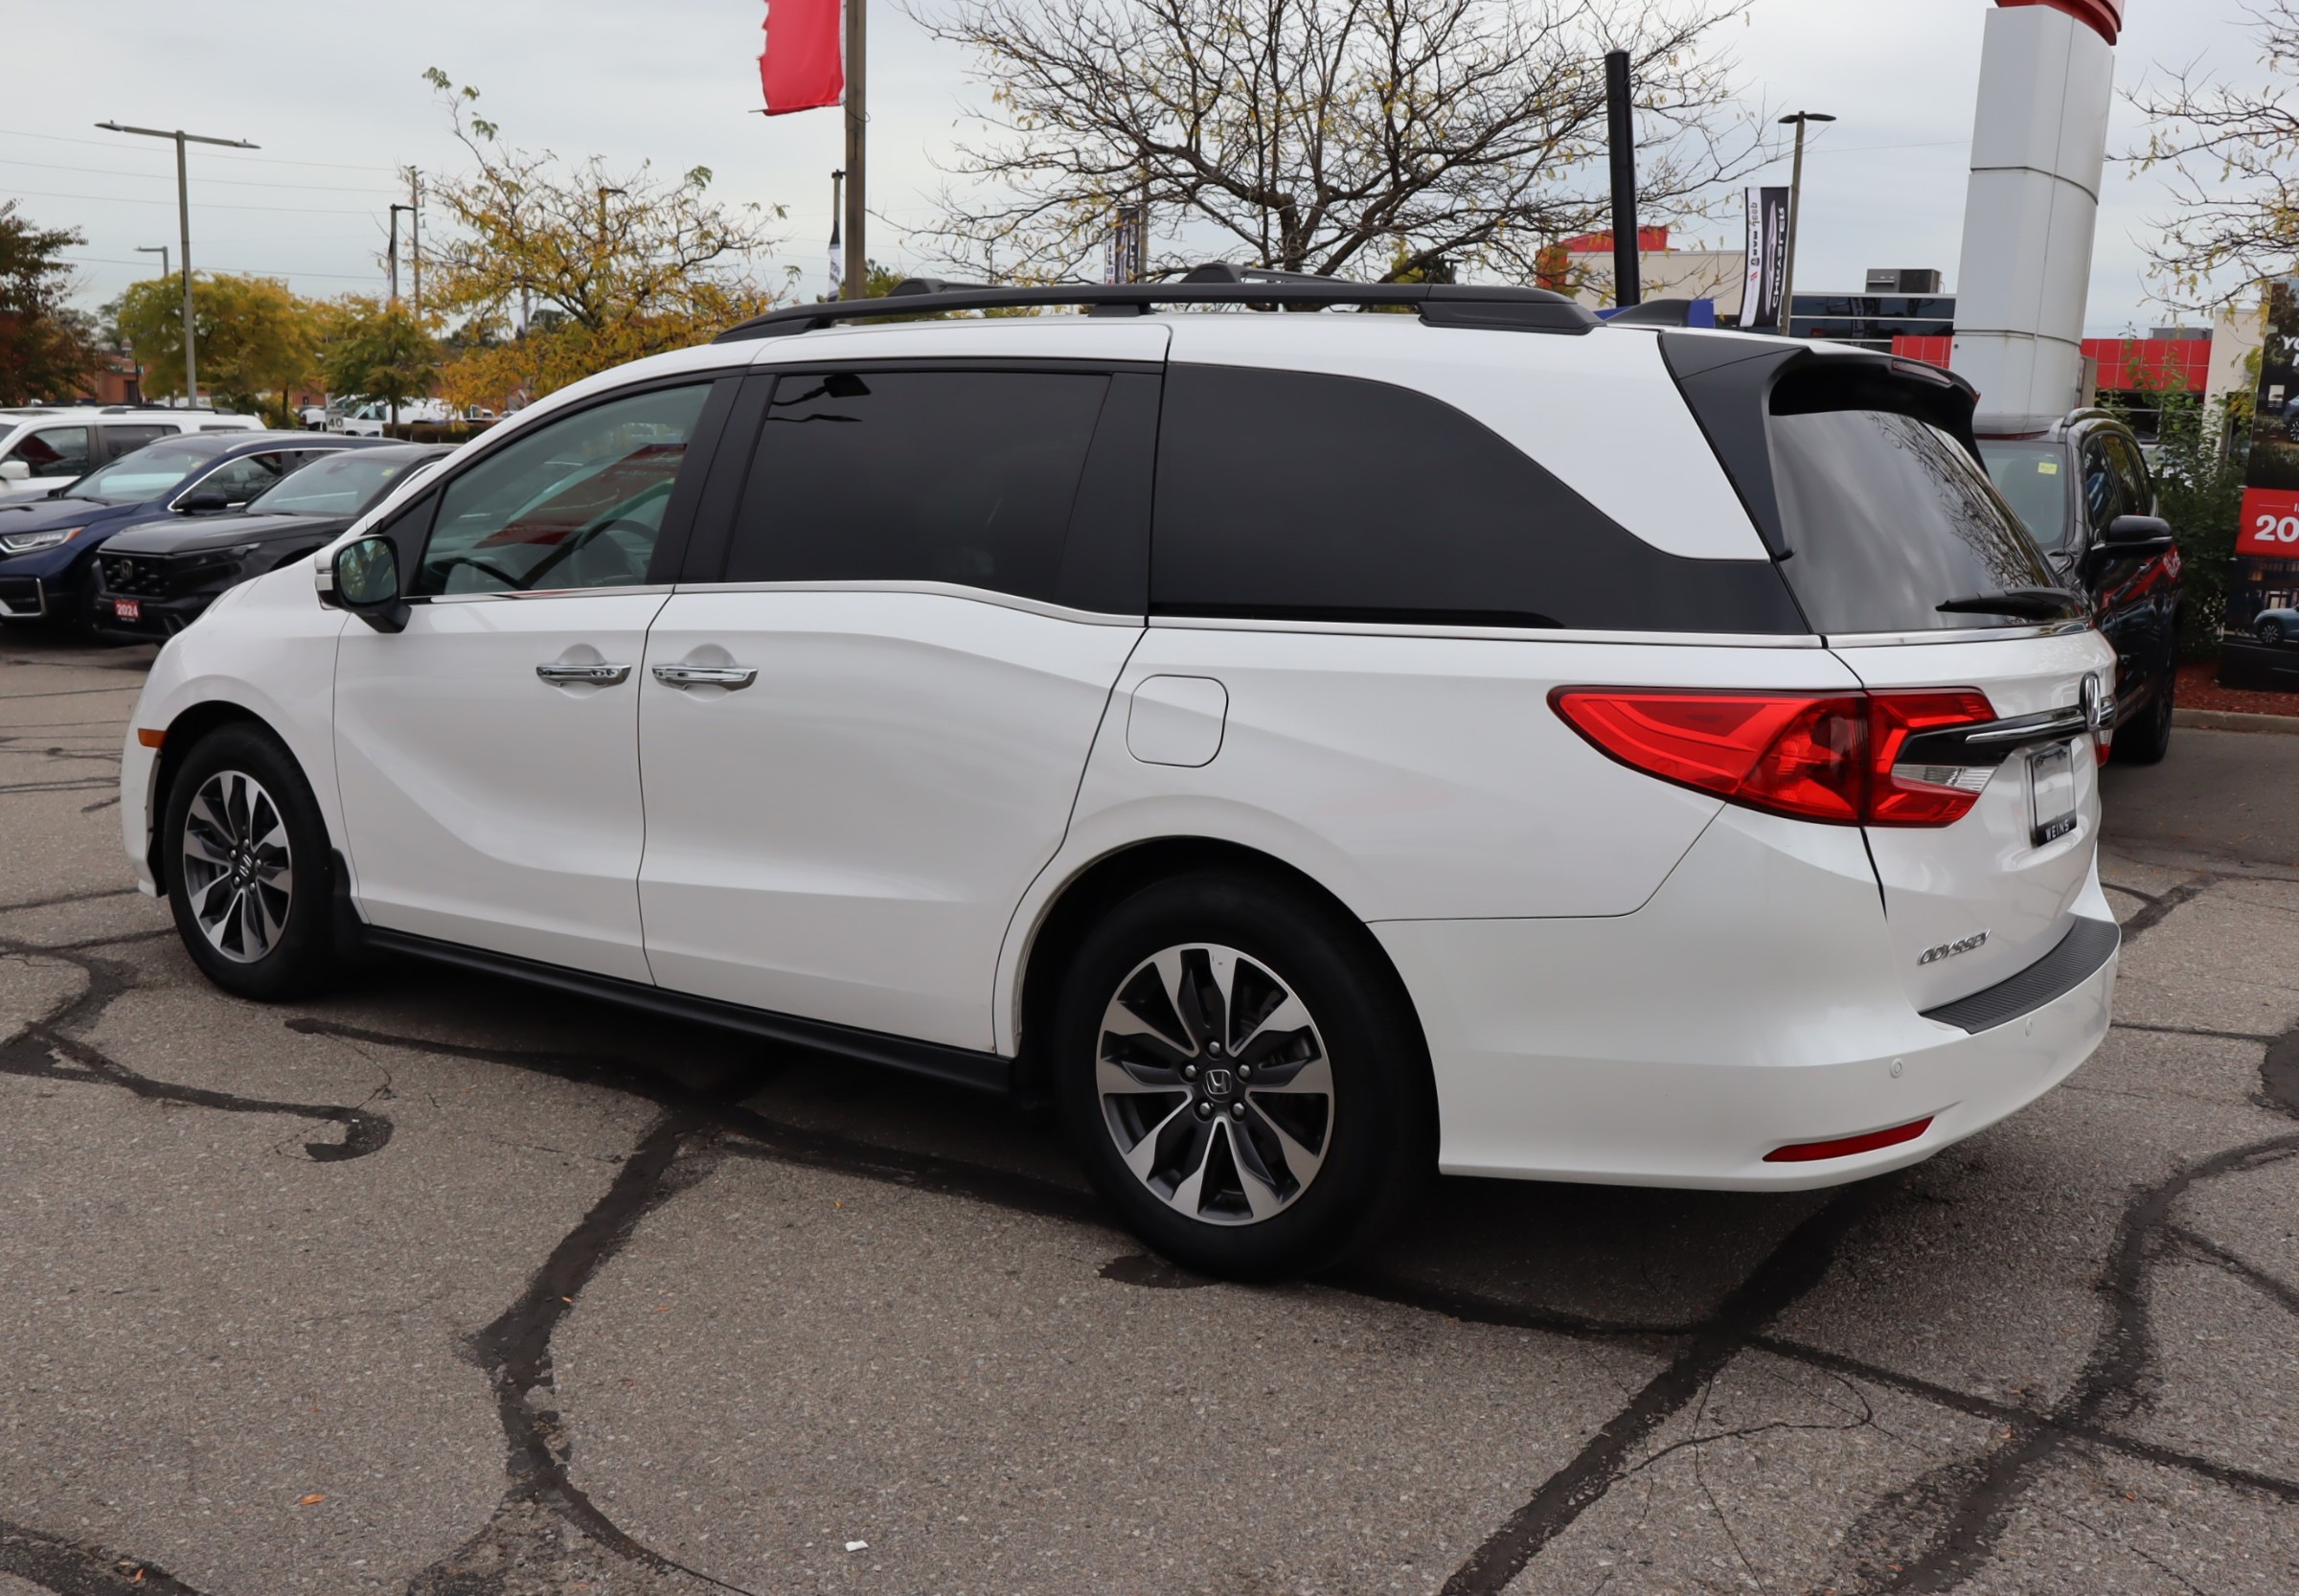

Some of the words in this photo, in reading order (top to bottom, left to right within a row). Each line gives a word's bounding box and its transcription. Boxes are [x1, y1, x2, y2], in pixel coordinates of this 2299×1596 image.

[328, 418, 343, 428] 40
[116, 604, 139, 618] 2024
[2045, 819, 2069, 841] WEINS
[1917, 928, 1992, 965] ODYSSEY
